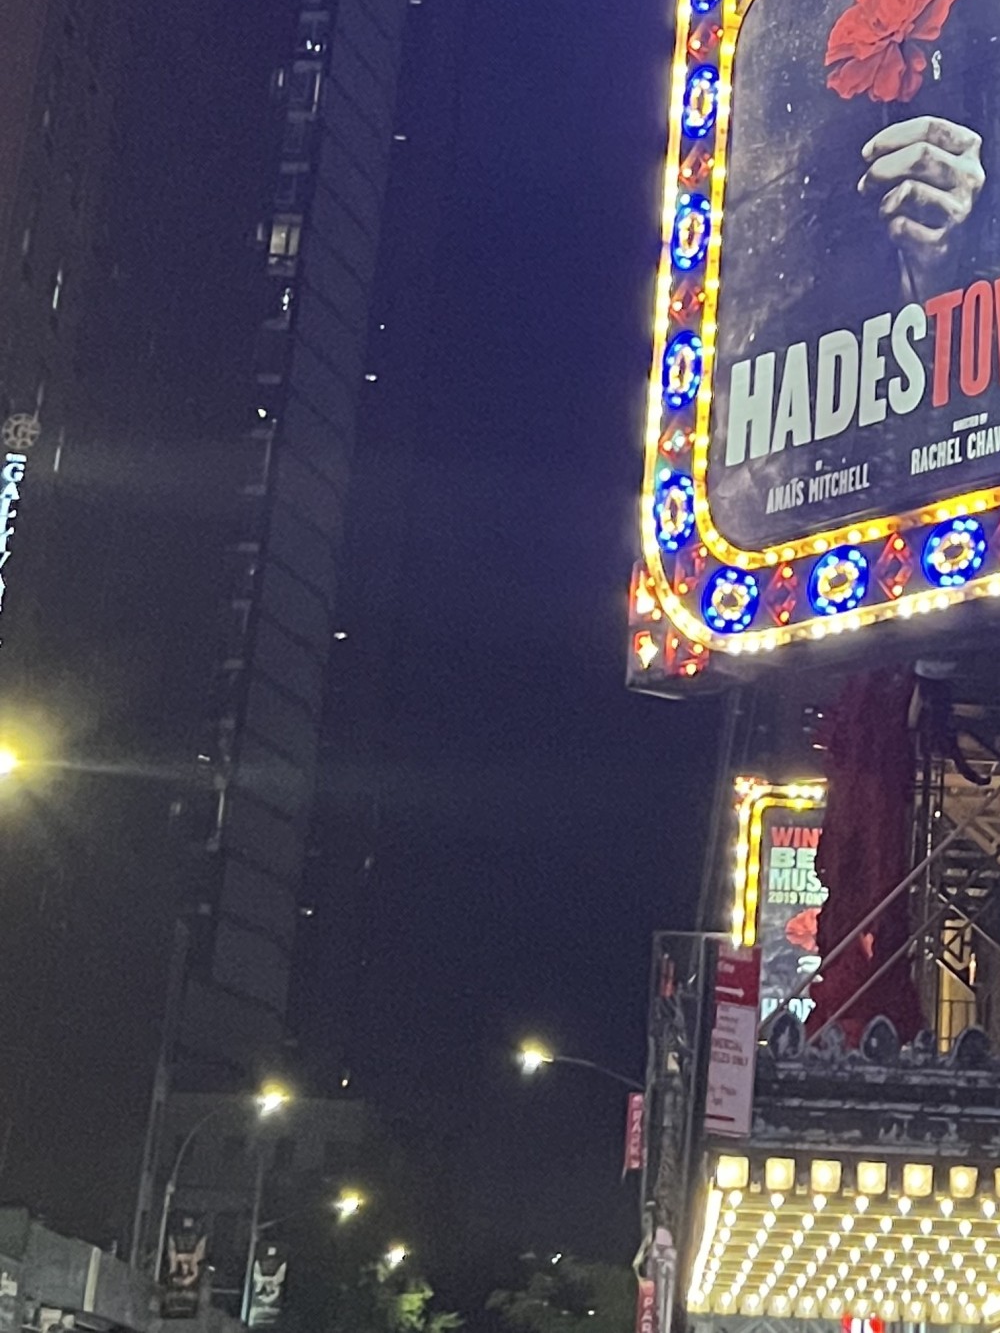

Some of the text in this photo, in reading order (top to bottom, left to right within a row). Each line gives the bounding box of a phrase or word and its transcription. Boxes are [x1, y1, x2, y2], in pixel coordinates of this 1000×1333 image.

[911, 436, 963, 475] RACHEL
[807, 462, 870, 504] MITCHELL
[771, 827, 823, 848] WIN
[768, 868, 829, 893] MUS
[767, 891, 798, 905] 2019
